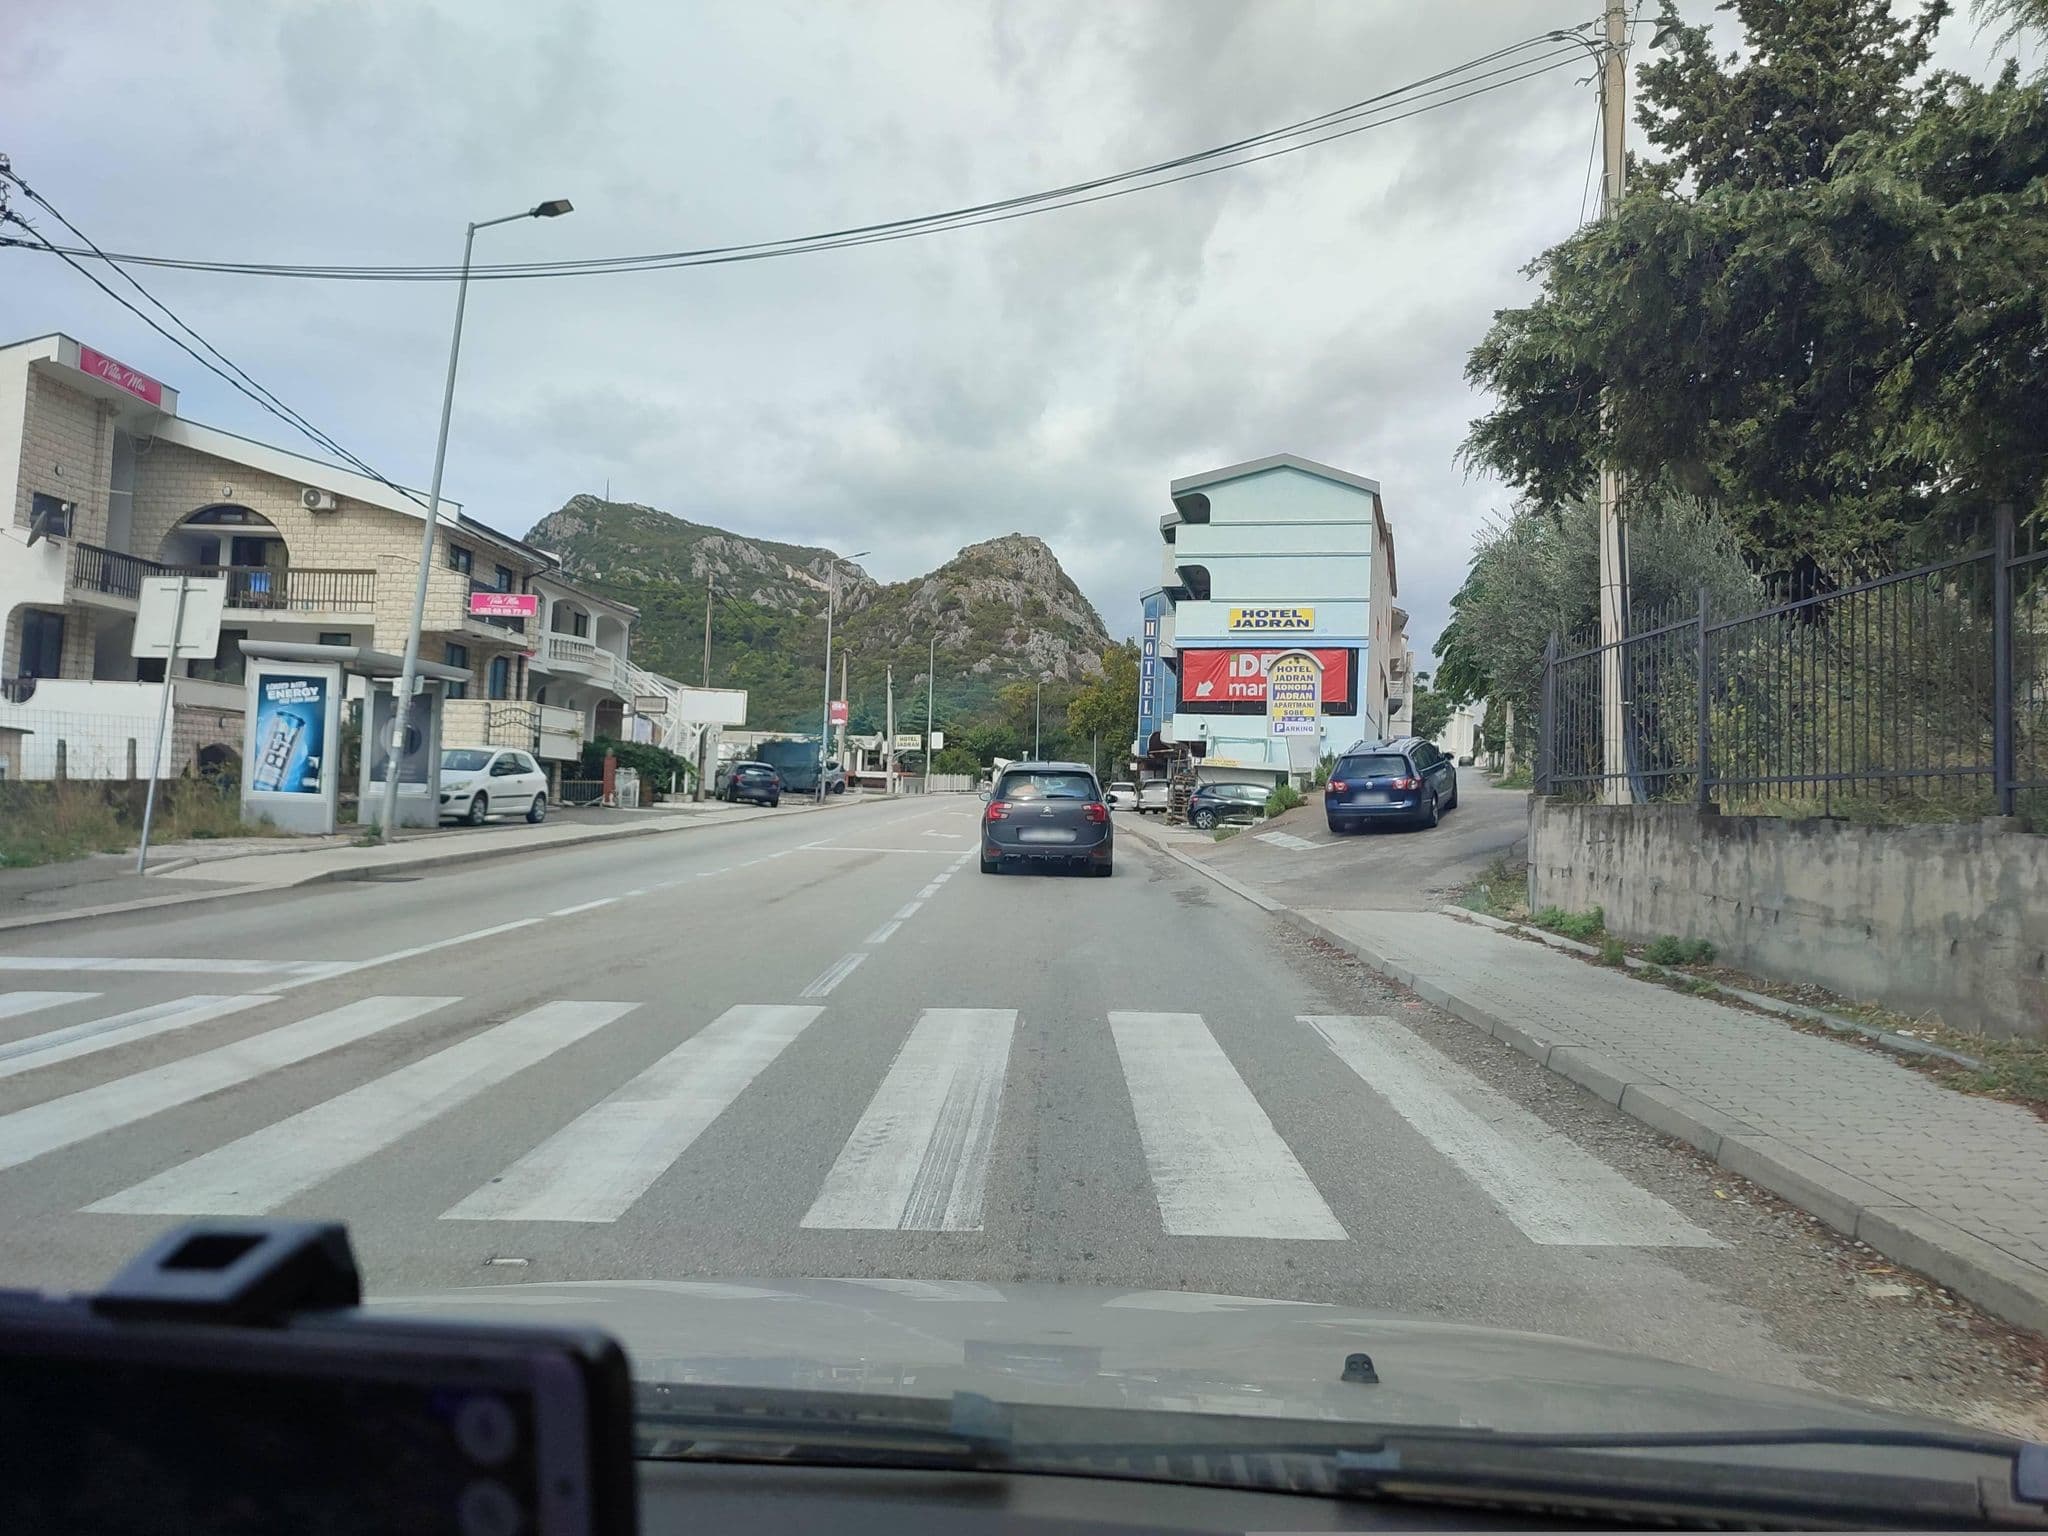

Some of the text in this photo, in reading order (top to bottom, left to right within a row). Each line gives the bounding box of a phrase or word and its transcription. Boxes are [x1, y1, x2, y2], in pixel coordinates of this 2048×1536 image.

[1241, 609, 1303, 618] HOTEL
[1233, 619, 1310, 628] JADRAN
[1144, 622, 1156, 715] HOTEL
[1277, 665, 1312, 673] HOTEL
[1275, 674, 1314, 682] JADRAN
[267, 687, 319, 700] ENERGY
[1275, 692, 1313, 700] JADRAN
